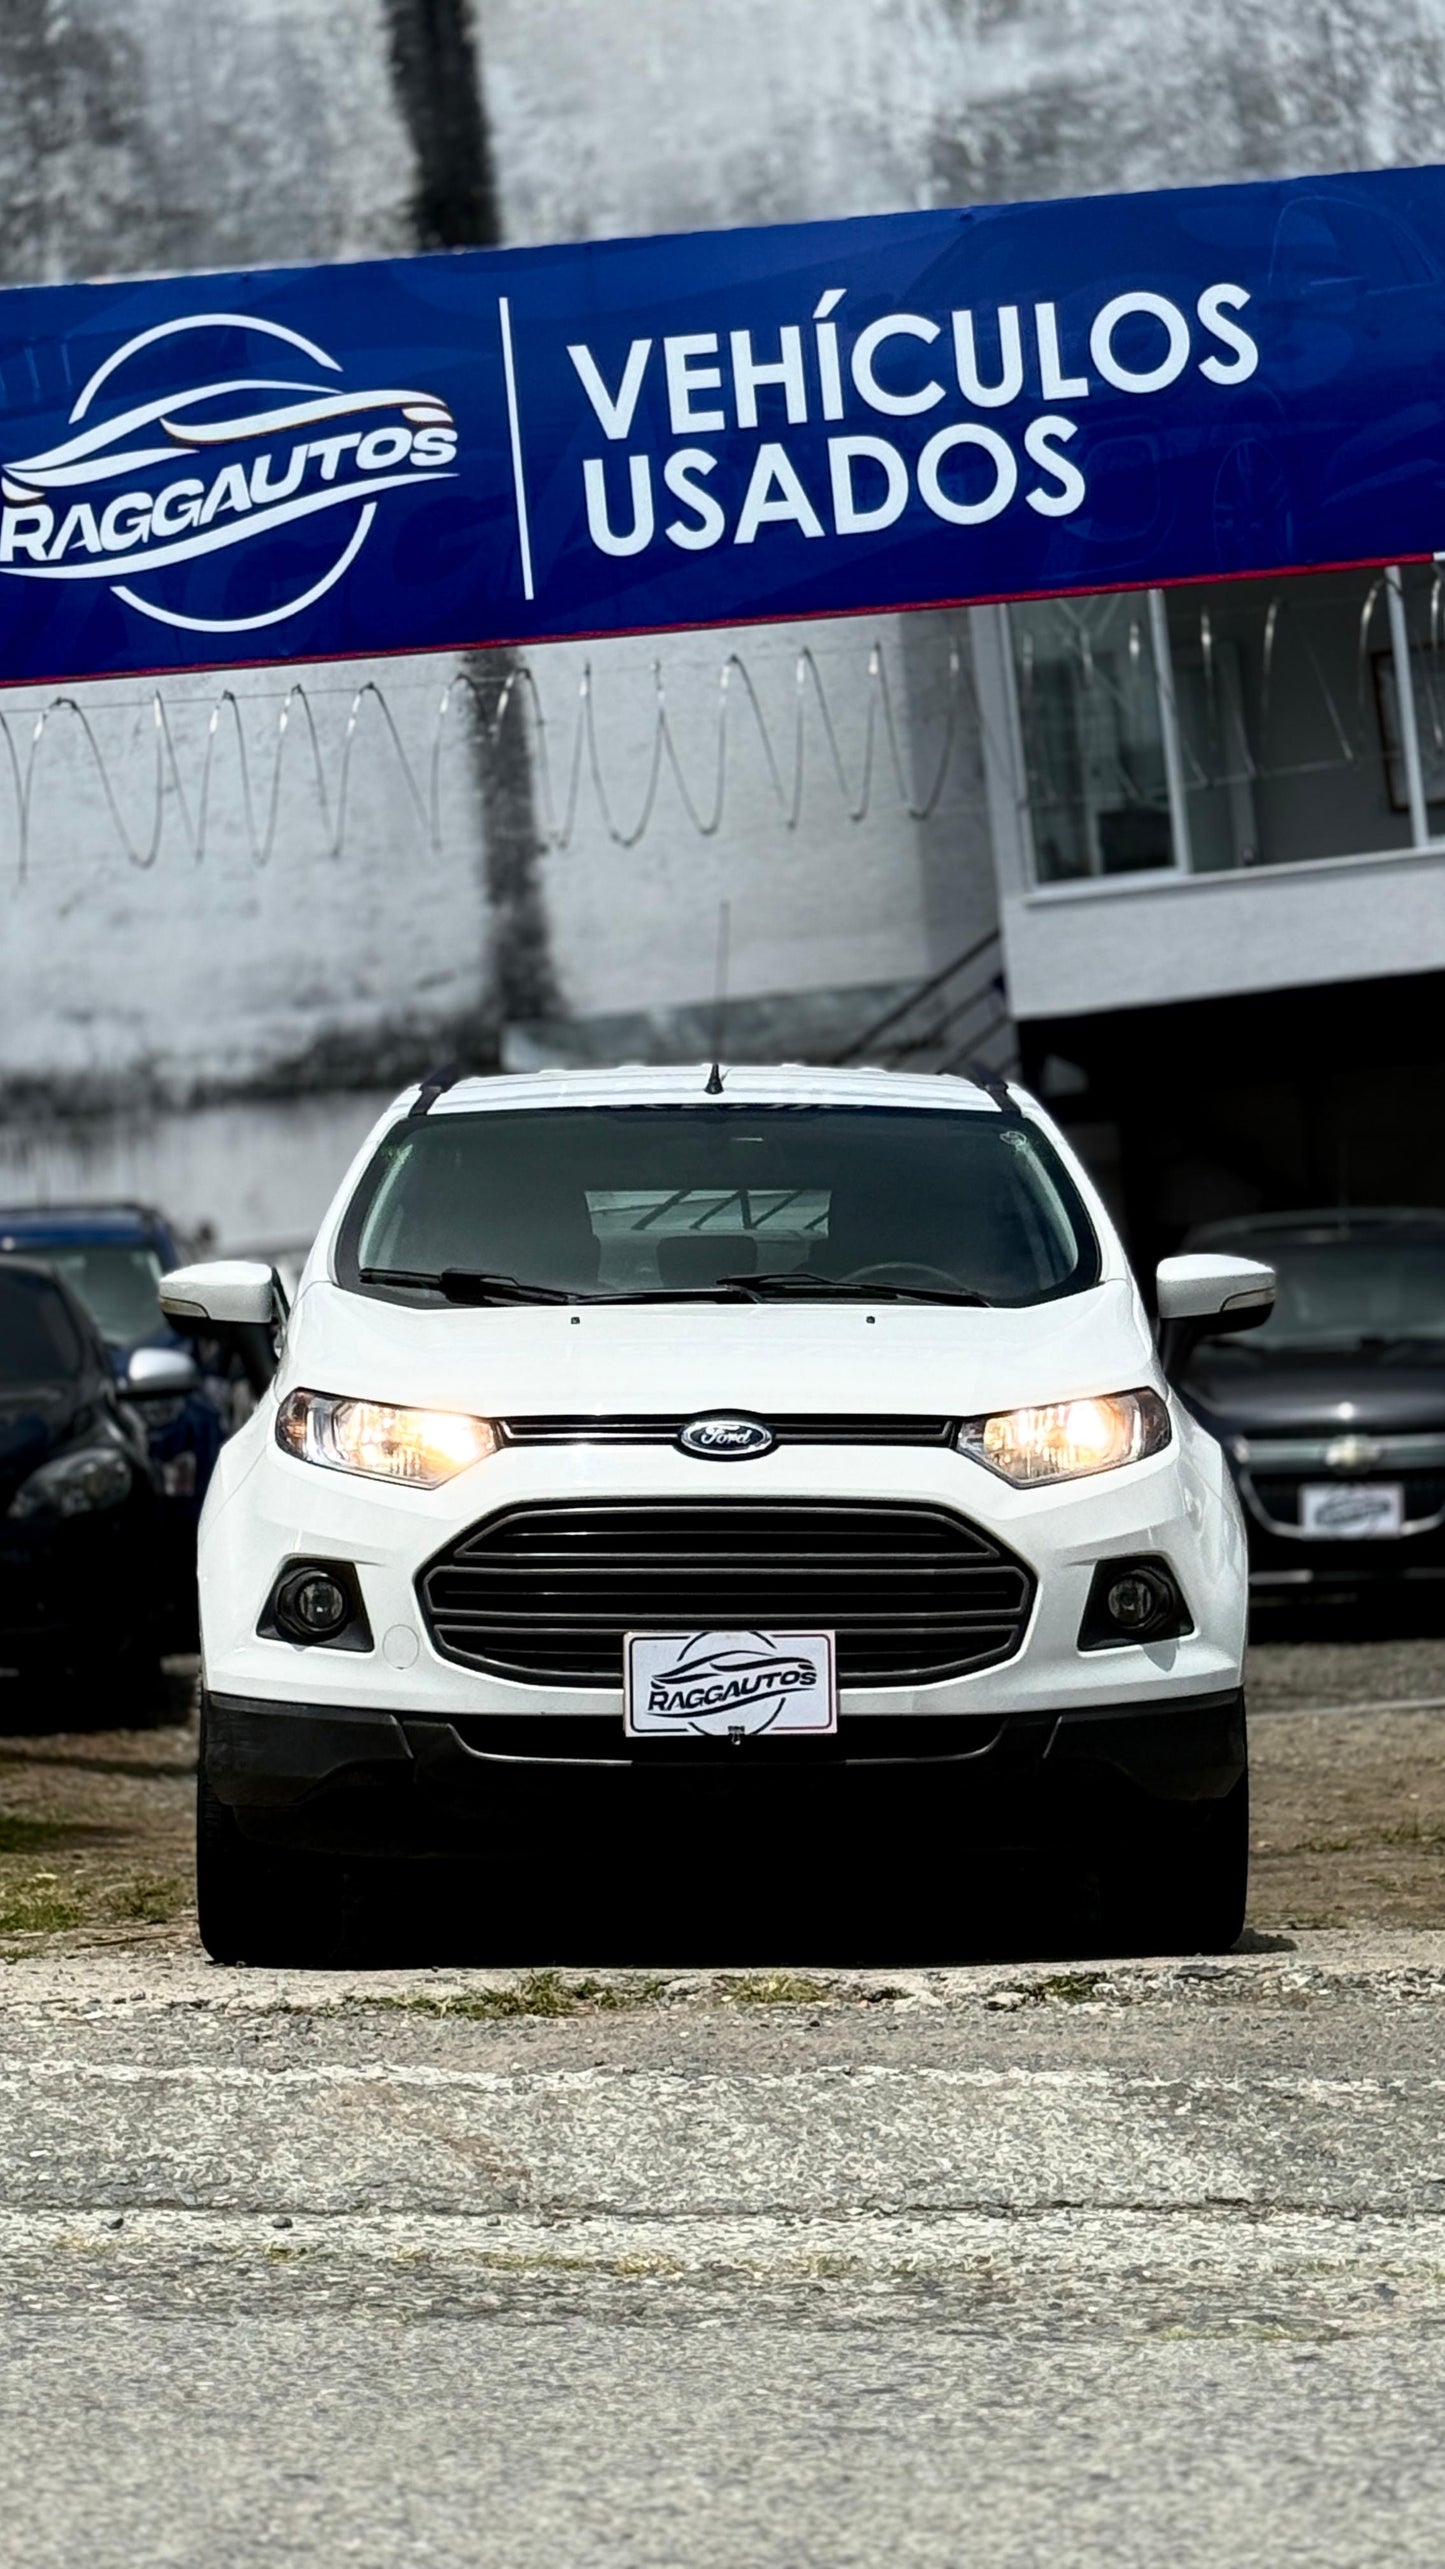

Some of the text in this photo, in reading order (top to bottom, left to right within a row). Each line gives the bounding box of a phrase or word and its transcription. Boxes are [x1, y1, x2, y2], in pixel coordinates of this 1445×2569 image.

[567, 283, 1259, 440] VEHÍCULOS
[0, 427, 458, 561] RAGGAUTOS
[583, 415, 1086, 557] USADOS
[701, 1425, 752, 1444] Ford
[648, 1670, 817, 1711] RAGGAUTOS
